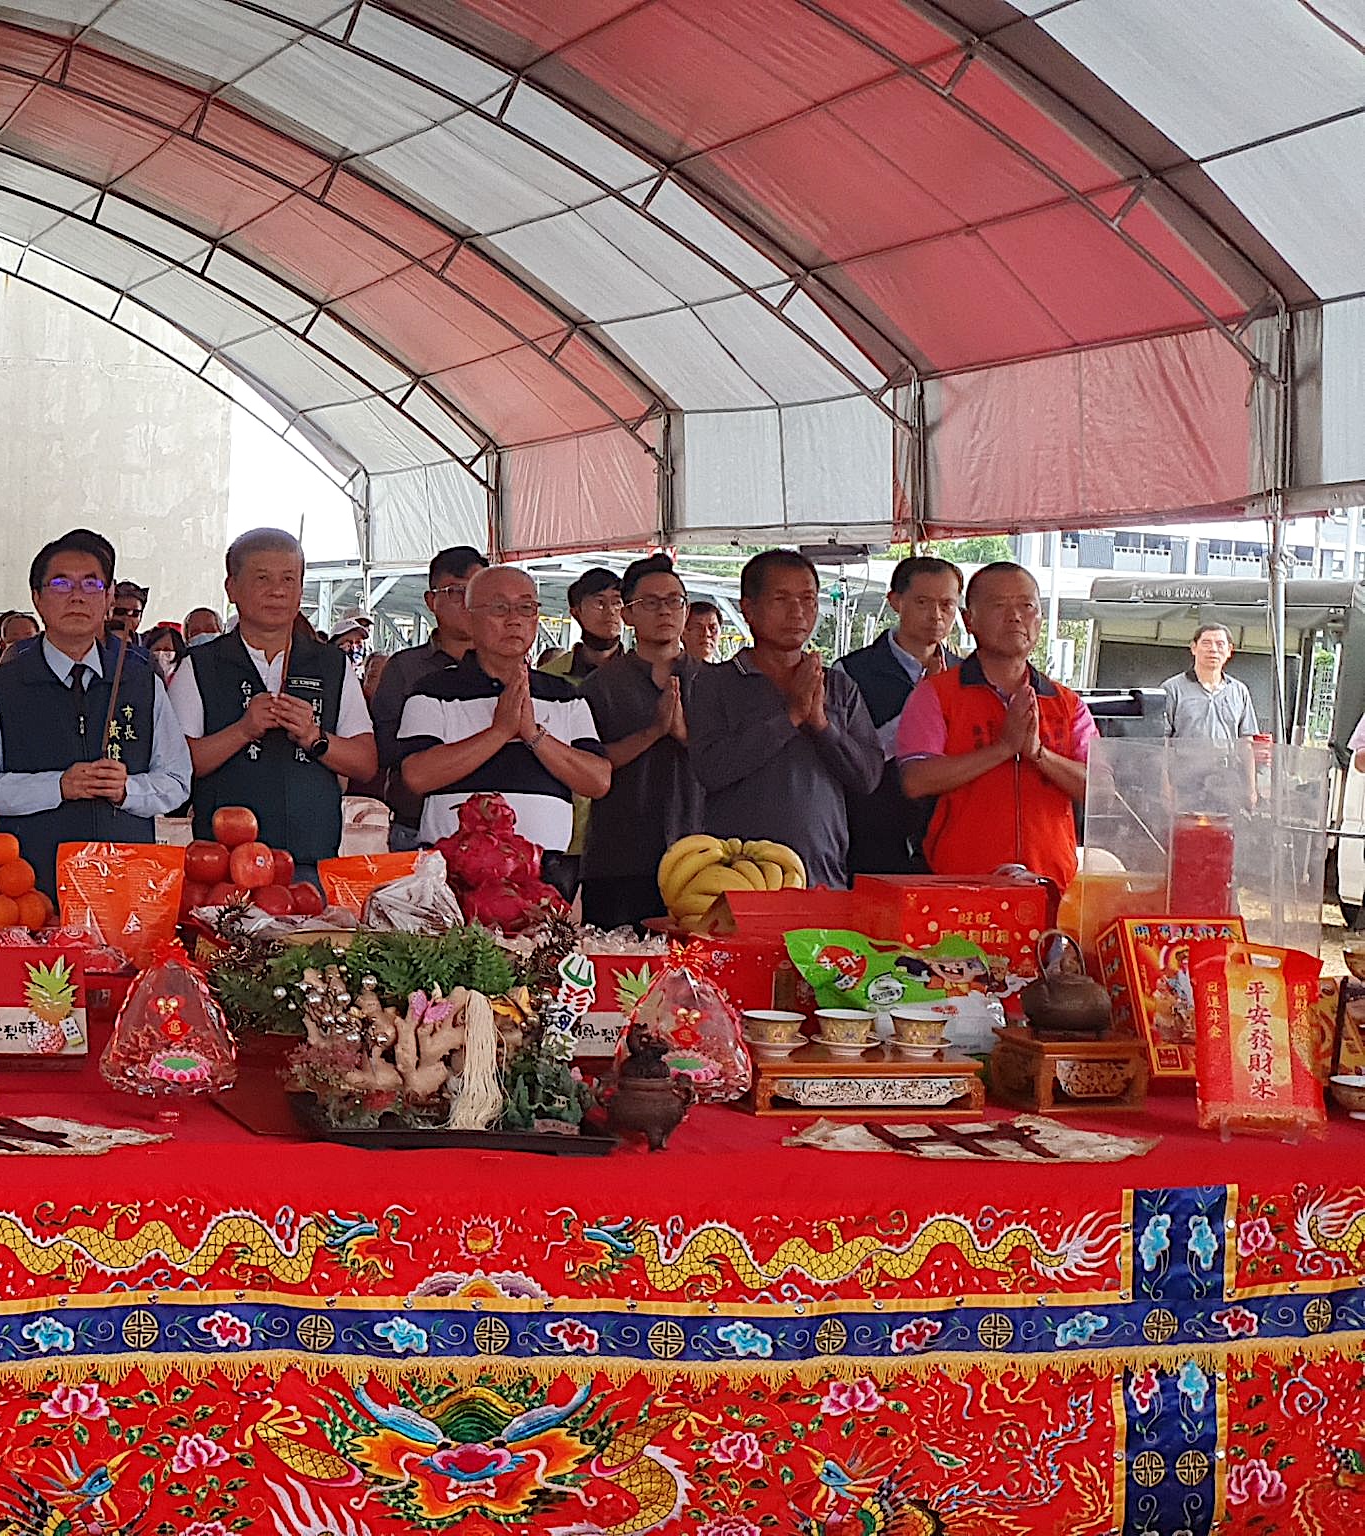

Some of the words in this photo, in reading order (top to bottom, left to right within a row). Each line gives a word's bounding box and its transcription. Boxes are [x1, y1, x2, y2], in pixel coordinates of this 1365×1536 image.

[121, 704, 138, 741] 市長
[1245, 980, 1276, 1100] 平安發財米
